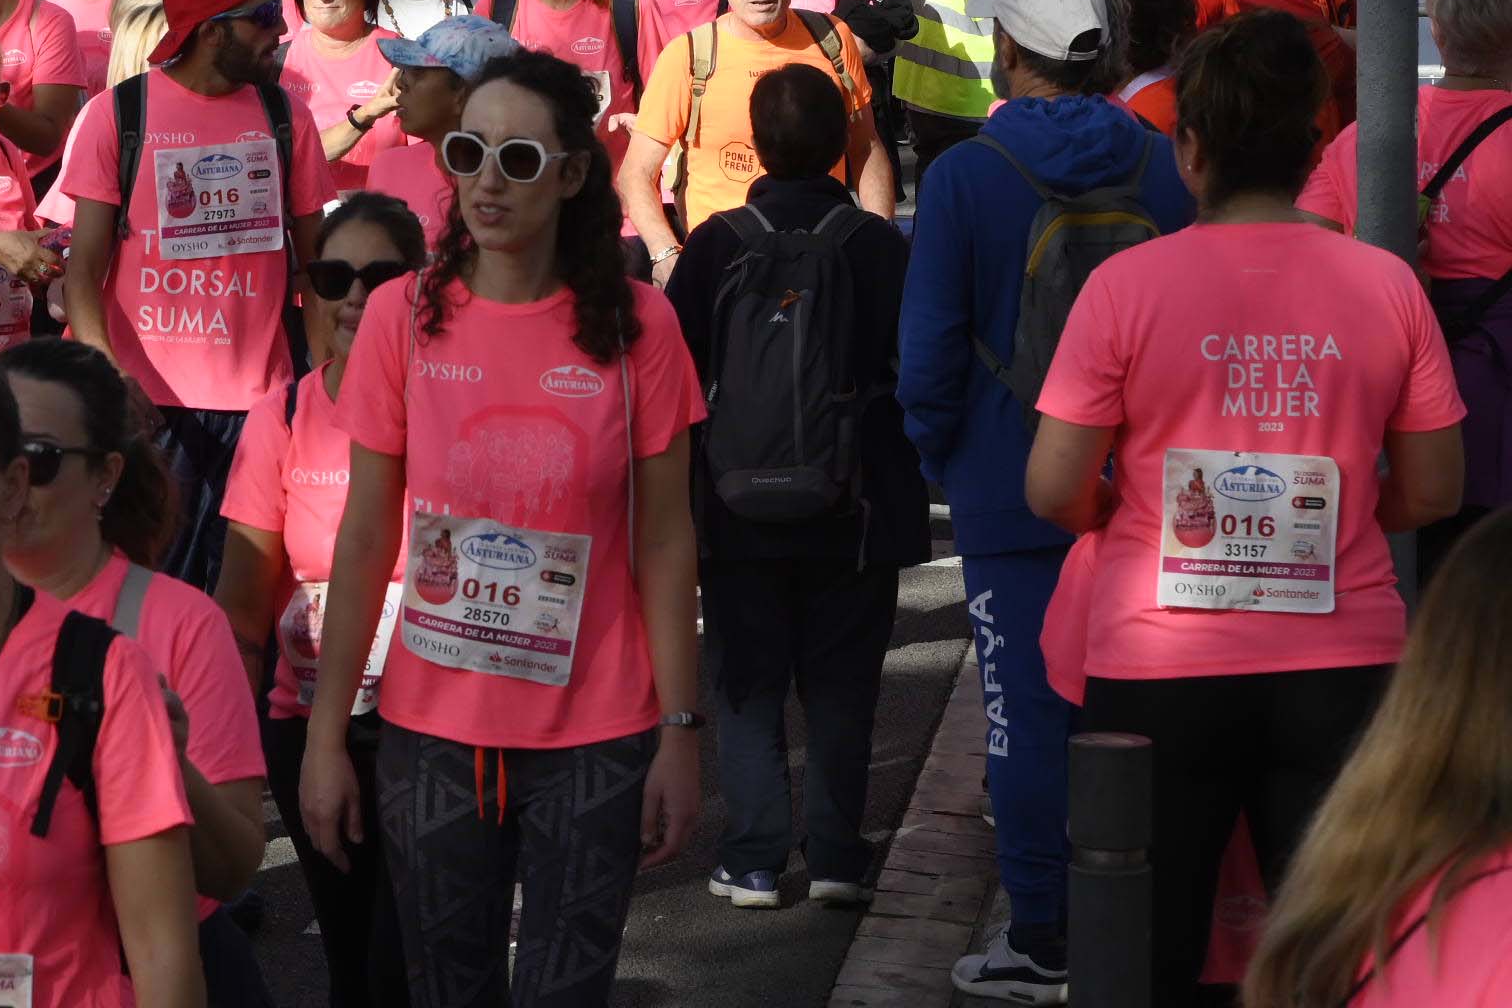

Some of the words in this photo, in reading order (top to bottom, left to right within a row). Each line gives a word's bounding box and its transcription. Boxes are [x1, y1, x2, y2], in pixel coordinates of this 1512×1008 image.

[725, 151, 755, 163] PONLE
[196, 165, 239, 177] ASTURIANA
[724, 160, 753, 173] FRENO
[199, 188, 239, 206] 016
[204, 209, 236, 221] 27973
[174, 226, 207, 235] CARRERA
[208, 225, 217, 233] DE
[141, 229, 156, 255] T
[172, 242, 208, 253] OYSHO
[140, 267, 256, 297] DORSAL
[137, 305, 228, 334] SUMA
[1200, 333, 1342, 362] CARRERA
[544, 374, 602, 393] ASTURIANA
[1228, 363, 1263, 389] DE
[1277, 363, 1315, 389] LA
[1221, 390, 1321, 418] MUJER
[1258, 421, 1284, 432] 2023
[291, 467, 349, 485] OYSHO
[1293, 476, 1326, 486] SUMA
[1219, 478, 1281, 494] ASTURIANA
[1221, 514, 1275, 537] 016
[466, 545, 529, 566] ASTURIANA
[543, 550, 577, 564] SUMA
[1225, 544, 1267, 558] 33157
[1180, 562, 1226, 573] CARRERA
[1227, 565, 1240, 573] DE
[1242, 565, 1255, 574] LA
[1256, 566, 1290, 575] MUJER
[1293, 568, 1317, 577] 2023
[463, 578, 521, 606] 016
[1175, 582, 1226, 596] OYSHO
[1266, 588, 1320, 600] Santander
[464, 607, 510, 626] 28570
[418, 615, 463, 634] CARRERA
[465, 625, 479, 638] DE
[481, 628, 494, 640] LA
[496, 631, 531, 647] MUJER
[413, 634, 460, 657] OYSHO
[504, 655, 558, 673] Santander
[969, 589, 1009, 757] BARÇA
